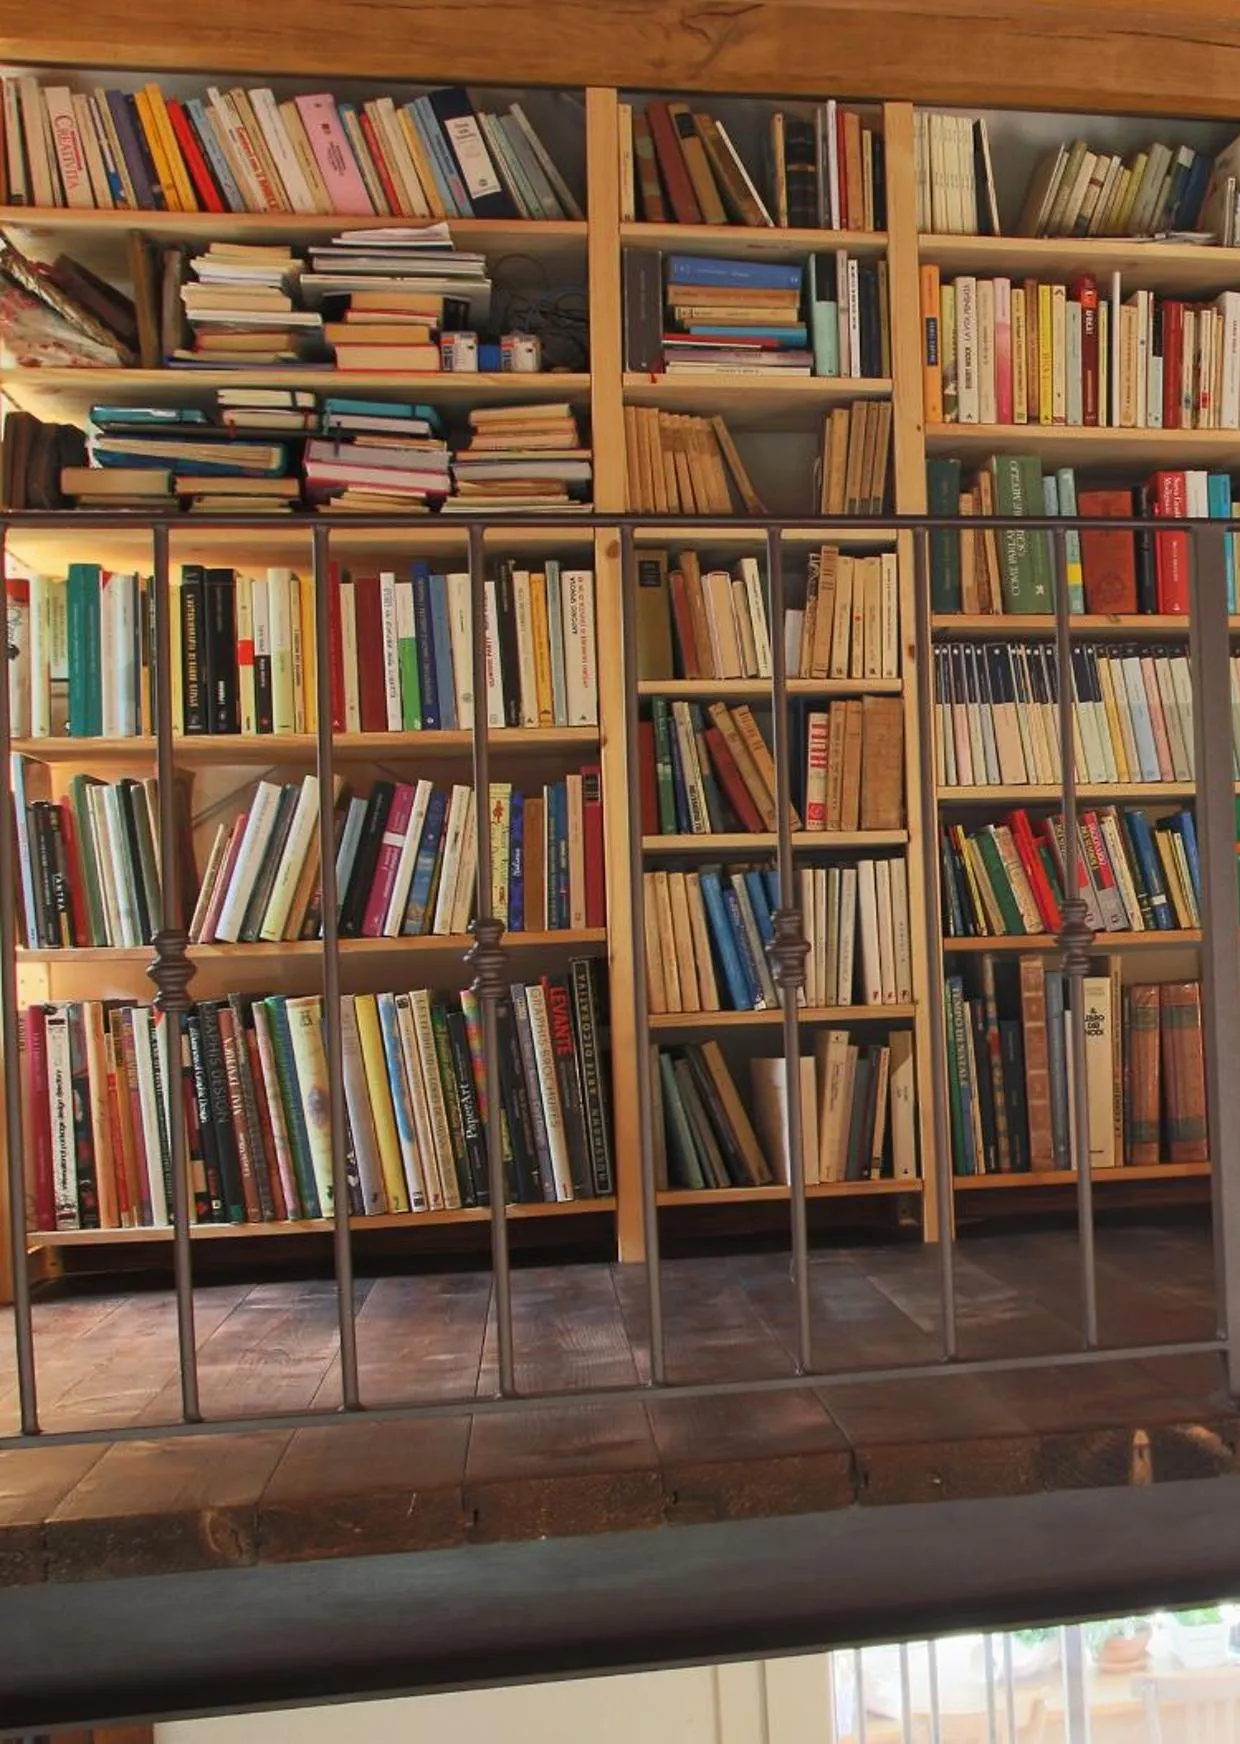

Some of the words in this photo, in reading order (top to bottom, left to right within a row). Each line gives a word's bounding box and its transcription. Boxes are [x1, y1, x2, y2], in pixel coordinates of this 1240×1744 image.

[1010, 460, 1022, 500] MEGLIO
[1010, 566, 1021, 596] COME
[531, 988, 547, 1047] GRAPHIS
[550, 987, 574, 1057] LEVANTE
[578, 974, 593, 1058] DECORATIVA
[211, 1070, 227, 1123] DESIGN
[586, 1062, 598, 1095] ARTE
[56, 1099, 64, 1120] design
[460, 1083, 480, 1139] PaperArt
[59, 1150, 68, 1190] international
